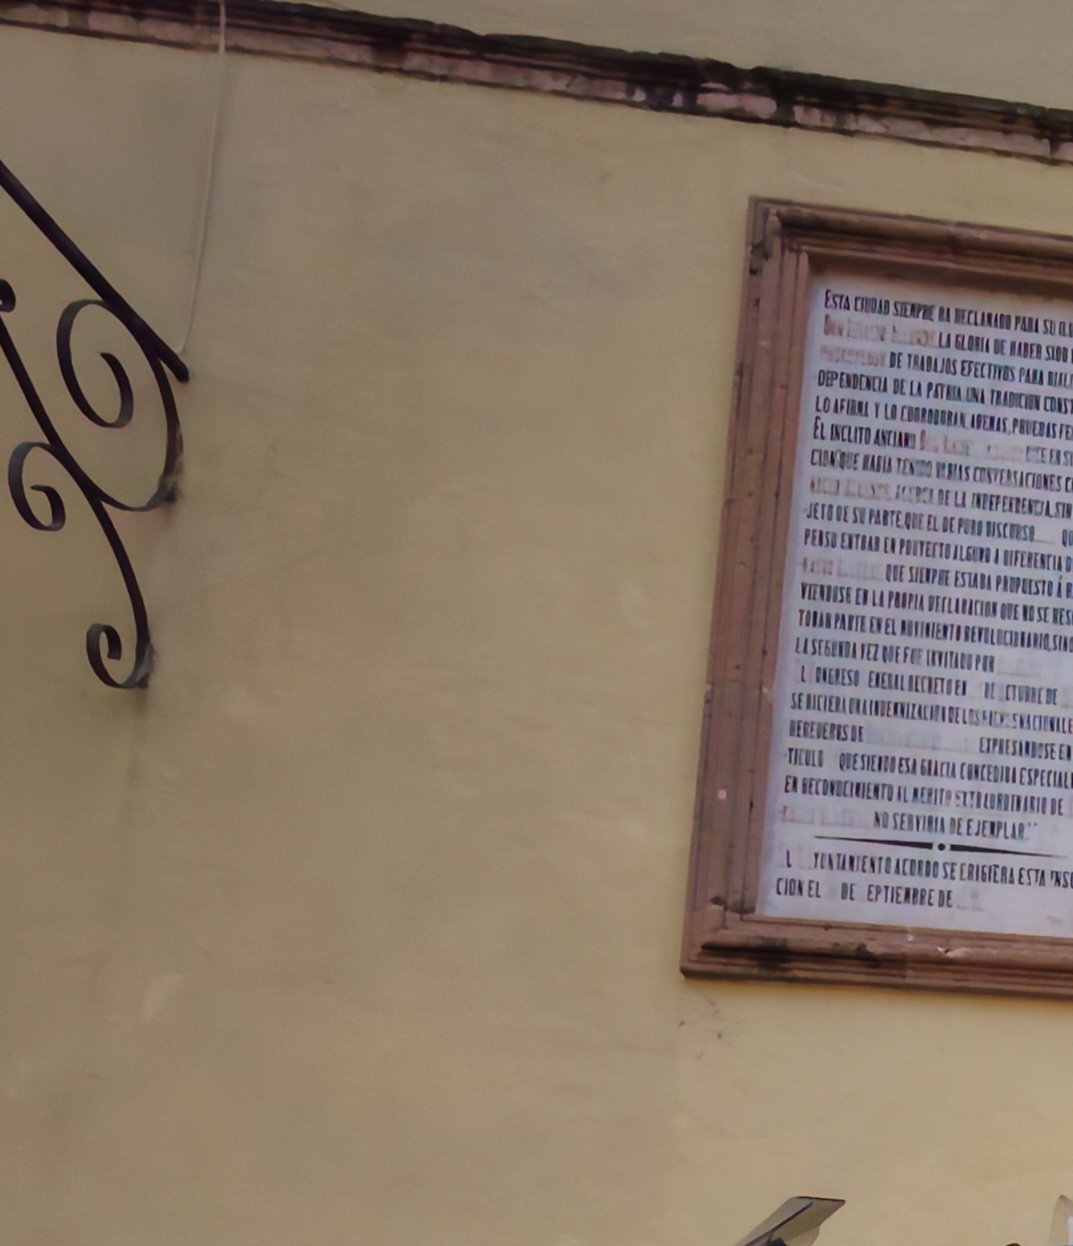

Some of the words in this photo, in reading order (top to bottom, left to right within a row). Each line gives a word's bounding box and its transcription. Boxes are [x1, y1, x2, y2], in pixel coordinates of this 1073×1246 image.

[1042, 318, 1056, 336] SU
[937, 330, 951, 349] LA
[954, 332, 990, 354] GLORIA
[992, 337, 1006, 356] DE
[888, 350, 903, 369] DE
[906, 352, 958, 376] TRABAJOS
[960, 359, 1015, 383] EFECTIVOS
[1018, 366, 1044, 386] PARA
[892, 377, 906, 396] DE
[909, 379, 922, 398] LA
[815, 394, 831, 413] LO
[883, 402, 897, 421] LO
[812, 415, 829, 441] EL
[937, 488, 950, 506] DE
[953, 490, 966, 508] LA
[835, 504, 849, 523] DE
[926, 514, 939, 532] EL
[941, 516, 955, 534] DE
[882, 536, 896, 554] EN
[884, 563, 905, 583] QUE
[871, 589, 885, 608] LA
[999, 601, 1019, 621] QUE
[1036, 605, 1050, 624] SE
[868, 615, 882, 634] EN
[883, 617, 898, 636] EL
[794, 636, 809, 655] LA
[860, 642, 879, 662] VEZ
[881, 644, 900, 664] QUE
[790, 691, 804, 710] SE
[849, 724, 865, 743] DE
[895, 784, 909, 803] AL
[1049, 797, 1064, 816] DE
[872, 810, 890, 830] NO
[948, 816, 963, 836] DE
[941, 861, 957, 880] SE
[806, 879, 822, 899] EL
[839, 882, 856, 901] DE
[936, 889, 953, 908] DE
